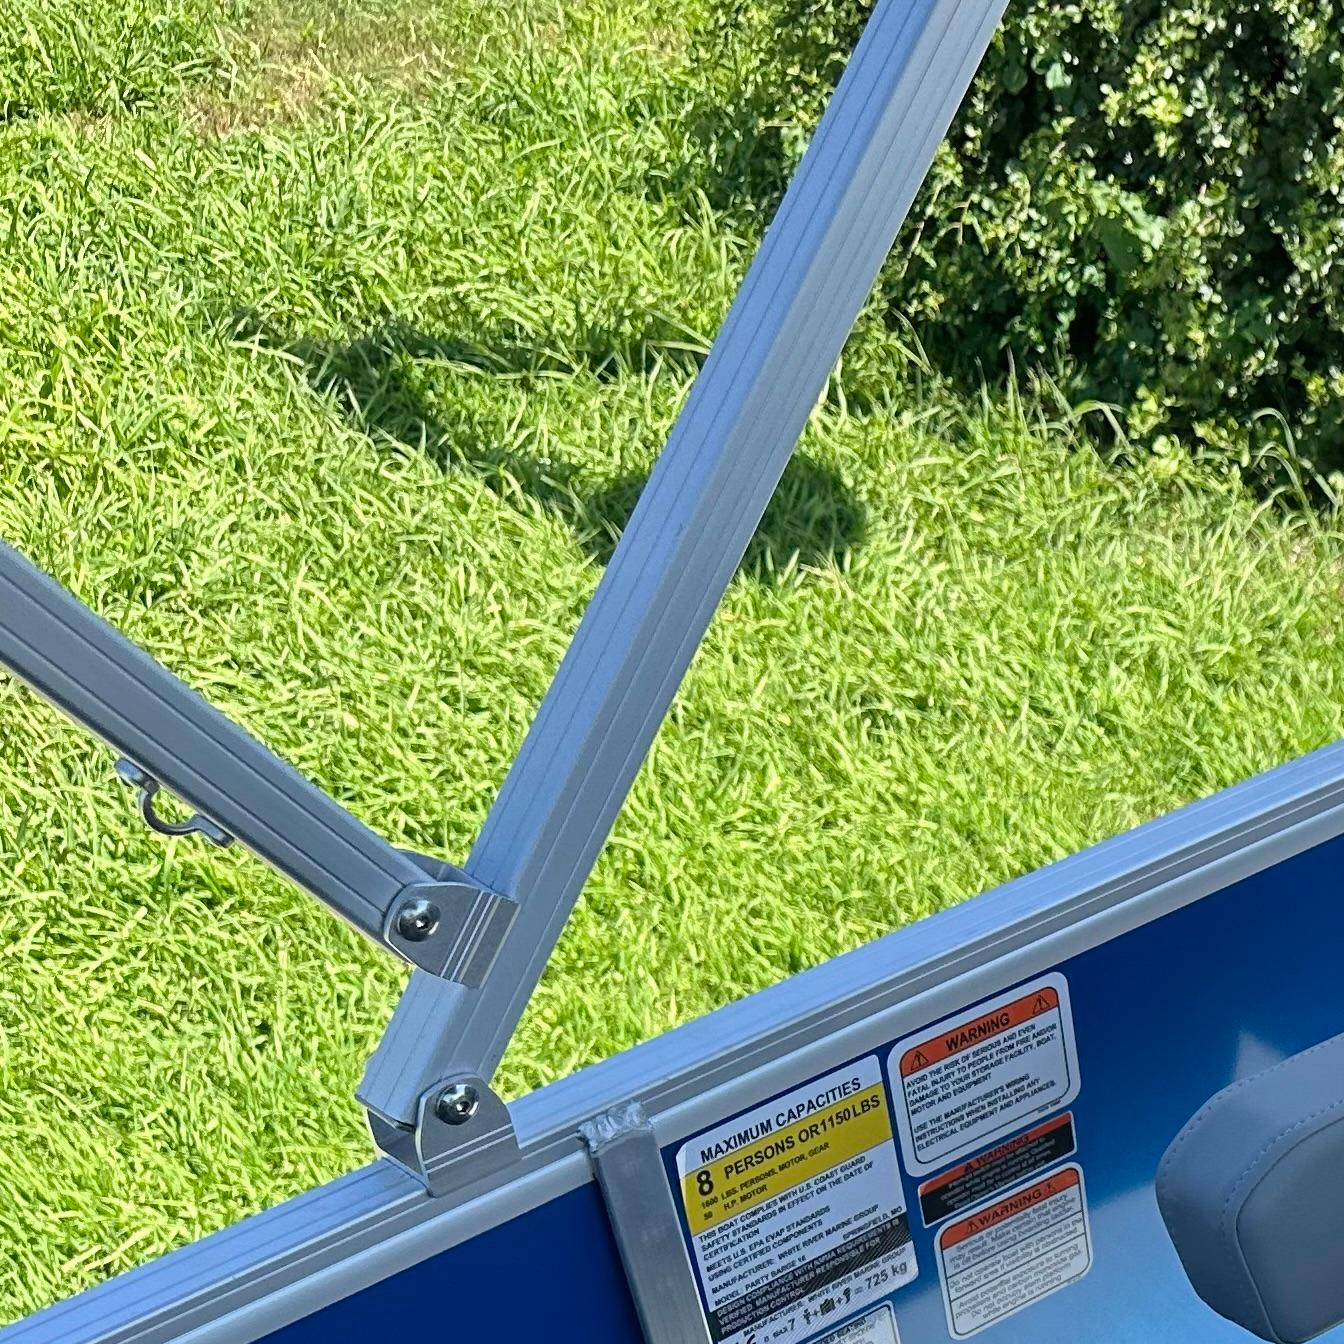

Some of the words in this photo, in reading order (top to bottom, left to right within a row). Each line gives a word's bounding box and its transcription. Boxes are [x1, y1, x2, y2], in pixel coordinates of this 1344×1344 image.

[906, 1072, 927, 1088] AVOID
[928, 1066, 942, 1078] THE
[943, 1057, 960, 1071] RISK
[960, 1053, 970, 1063] OF
[972, 1039, 1001, 1058] SERIOUS
[1002, 1032, 1016, 1044] AND
[1017, 1023, 1035, 1037] EVEN
[945, 1011, 1010, 1052] WARNING
[907, 1081, 929, 1097] FATAL
[931, 1069, 955, 1086] INJURY
[956, 1064, 966, 1074] TO
[967, 1051, 994, 1069] PEOPLE
[995, 1042, 1014, 1056] FROM
[1015, 1035, 1030, 1047] FIRE
[909, 1087, 938, 1106] DAMAGE
[939, 1082, 950, 1092] TO
[950, 1072, 970, 1087] YOUR
[971, 1057, 1004, 1078] STORAGE
[699, 1118, 772, 1164] MAXIMUM
[774, 1076, 861, 1128] CAPACITIES
[910, 1098, 935, 1115] MOTOR
[936, 1090, 952, 1103] AND
[952, 1072, 991, 1096] EQUIPMENT
[965, 1102, 986, 1118] WHEN
[1026, 1077, 1040, 1089] ANY
[696, 1169, 714, 1196] 8
[723, 1134, 795, 1179] PERSONS
[797, 1121, 820, 1144] OR
[819, 1106, 851, 1133] 1150
[852, 1092, 880, 1117] LBS
[913, 1120, 928, 1133] USE
[928, 1113, 942, 1126] THE
[916, 1125, 958, 1151] ELECTRICAL
[959, 1106, 998, 1130] EQUIPMENT
[999, 1099, 1013, 1111] AND
[739, 1166, 778, 1192] PERSONS,
[778, 1151, 807, 1173] MOTOR,
[807, 1140, 829, 1157] GEAR
[739, 1183, 767, 1203] MOTOR
[698, 1228, 716, 1243] THIS
[717, 1217, 738, 1234] BOAT
[739, 1198, 777, 1223] COMPLIES
[778, 1188, 797, 1203] WITH
[813, 1168, 839, 1186] COAST
[839, 1154, 866, 1173] GUARD
[701, 1232, 730, 1252] SAFETY
[731, 1209, 777, 1237] STANDARDS
[778, 1204, 786, 1214] IN
[787, 1190, 814, 1209] EFFECT
[815, 1184, 827, 1195] ON
[828, 1176, 842, 1189] THE
[843, 1166, 863, 1181] DATE
[863, 1160, 874, 1171] OF
[978, 1188, 1041, 1227] WARNING
[703, 1227, 760, 1261] CERTIFICATION
[705, 1254, 731, 1273] MEETS
[748, 1237, 764, 1251] EPA
[765, 1227, 784, 1243] EVAP
[785, 1204, 830, 1232] STANDARDS
[707, 1264, 732, 1282] USING
[733, 1244, 771, 1269] CERTIFIED
[772, 1218, 822, 1249] COMPONENTS
[777, 1243, 801, 1261] WHITE
[802, 1231, 824, 1248] RIVER
[825, 1217, 852, 1236] MARINE
[853, 1203, 879, 1222] GROUP
[717, 1296, 745, 1317] DESIGN
[793, 1261, 813, 1277] WITH
[745, 1273, 769, 1291] PARTY
[770, 1259, 796, 1278] BARGE
[787, 1316, 796, 1330] 7
[864, 1268, 888, 1291] 725
[890, 1258, 908, 1279] kg
